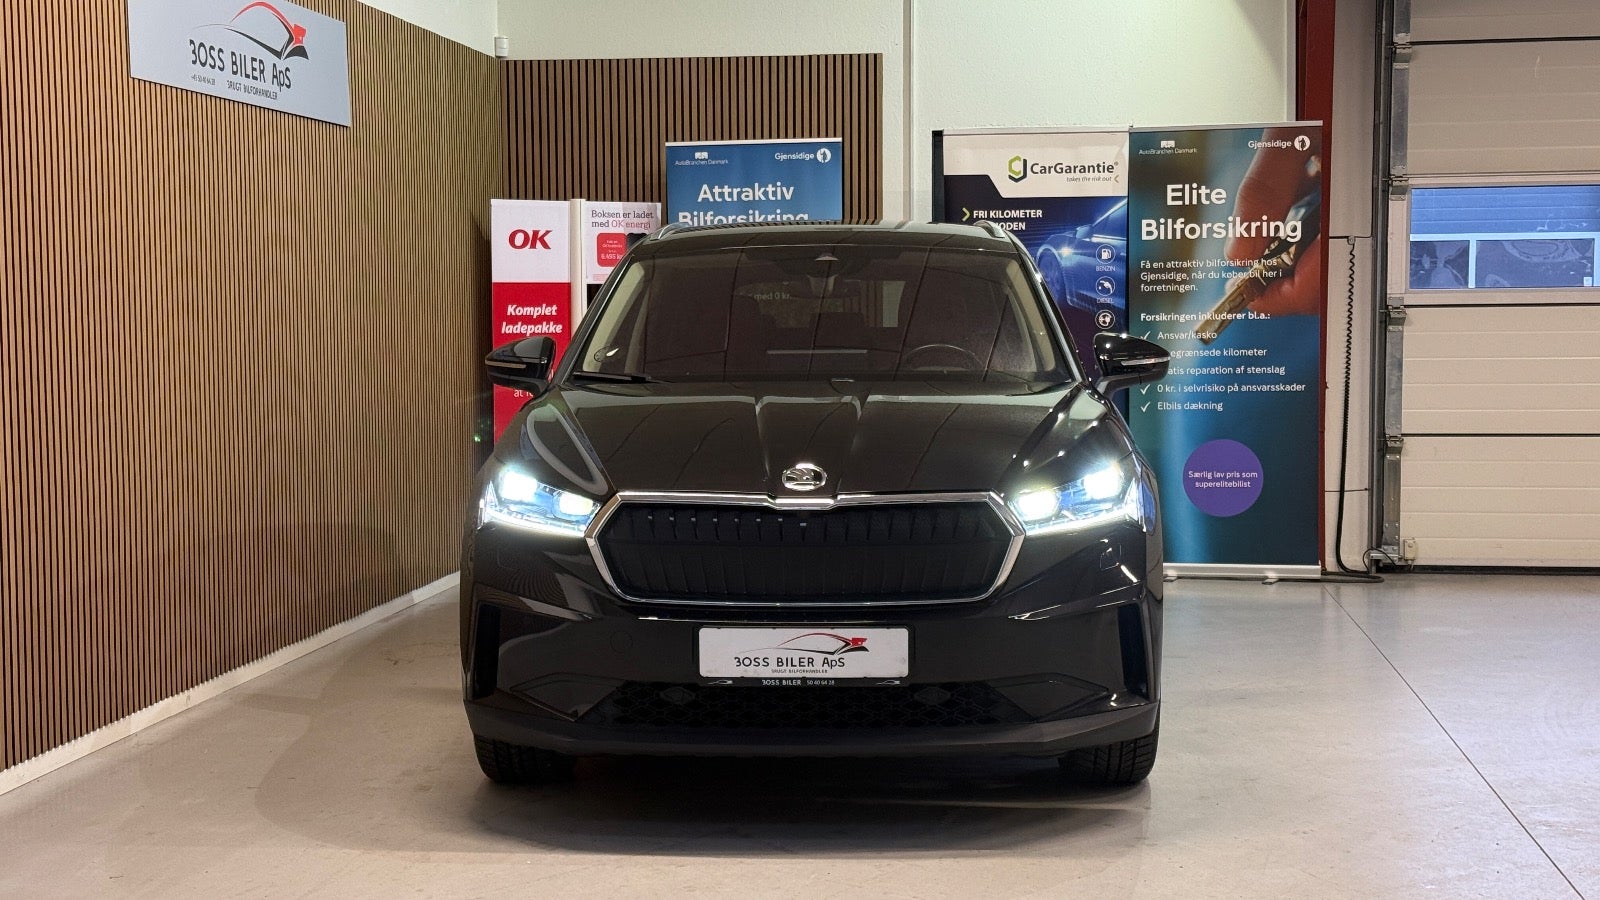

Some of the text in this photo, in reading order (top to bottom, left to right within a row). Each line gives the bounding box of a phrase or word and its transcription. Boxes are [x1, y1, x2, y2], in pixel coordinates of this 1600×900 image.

[231, 52, 265, 82] BILER
[272, 63, 291, 91] ApS
[244, 84, 277, 100] BILFORHANDLER
[1248, 140, 1292, 150] Gjensidige
[775, 153, 814, 161] Gjensidige
[697, 182, 794, 202] Attraktiv
[1167, 183, 1227, 206] Elite
[592, 210, 621, 218] Boksen
[973, 210, 1042, 218] FRI KILOMETER
[611, 220, 624, 228] OK
[626, 221, 651, 230] energi
[1142, 215, 1302, 243] Bilforsikring
[508, 229, 552, 250] OK
[1140, 260, 1151, 268] Få
[1166, 260, 1204, 268] attraktiv
[1206, 258, 1259, 267] bilforsikring
[1262, 258, 1277, 266] hos
[1140, 272, 1189, 282] Gjensidige,
[1192, 270, 1206, 278] når
[1249, 270, 1260, 278] bil
[1141, 284, 1198, 293] forretningen.
[507, 304, 557, 318] Komplet
[1141, 313, 1196, 322] Forsikringen
[1199, 312, 1246, 321] inkluderer
[502, 322, 562, 336] ladepakke
[1157, 331, 1217, 340] Ansvar/kasko
[1170, 348, 1267, 358] egrænsede kilometer
[1168, 365, 1286, 376] atis reparation af stenslag
[1157, 384, 1163, 392] 0
[1184, 384, 1225, 392] selvrisiko
[1228, 383, 1238, 394] på
[1241, 383, 1306, 392] ansvarsskader
[1157, 401, 1223, 411] Elbils dækning
[1189, 471, 1212, 479] Særlig
[1226, 471, 1240, 479] pris
[1195, 480, 1251, 489] superelitebilist
[776, 657, 814, 667] BILER
[822, 657, 845, 669] ApS
